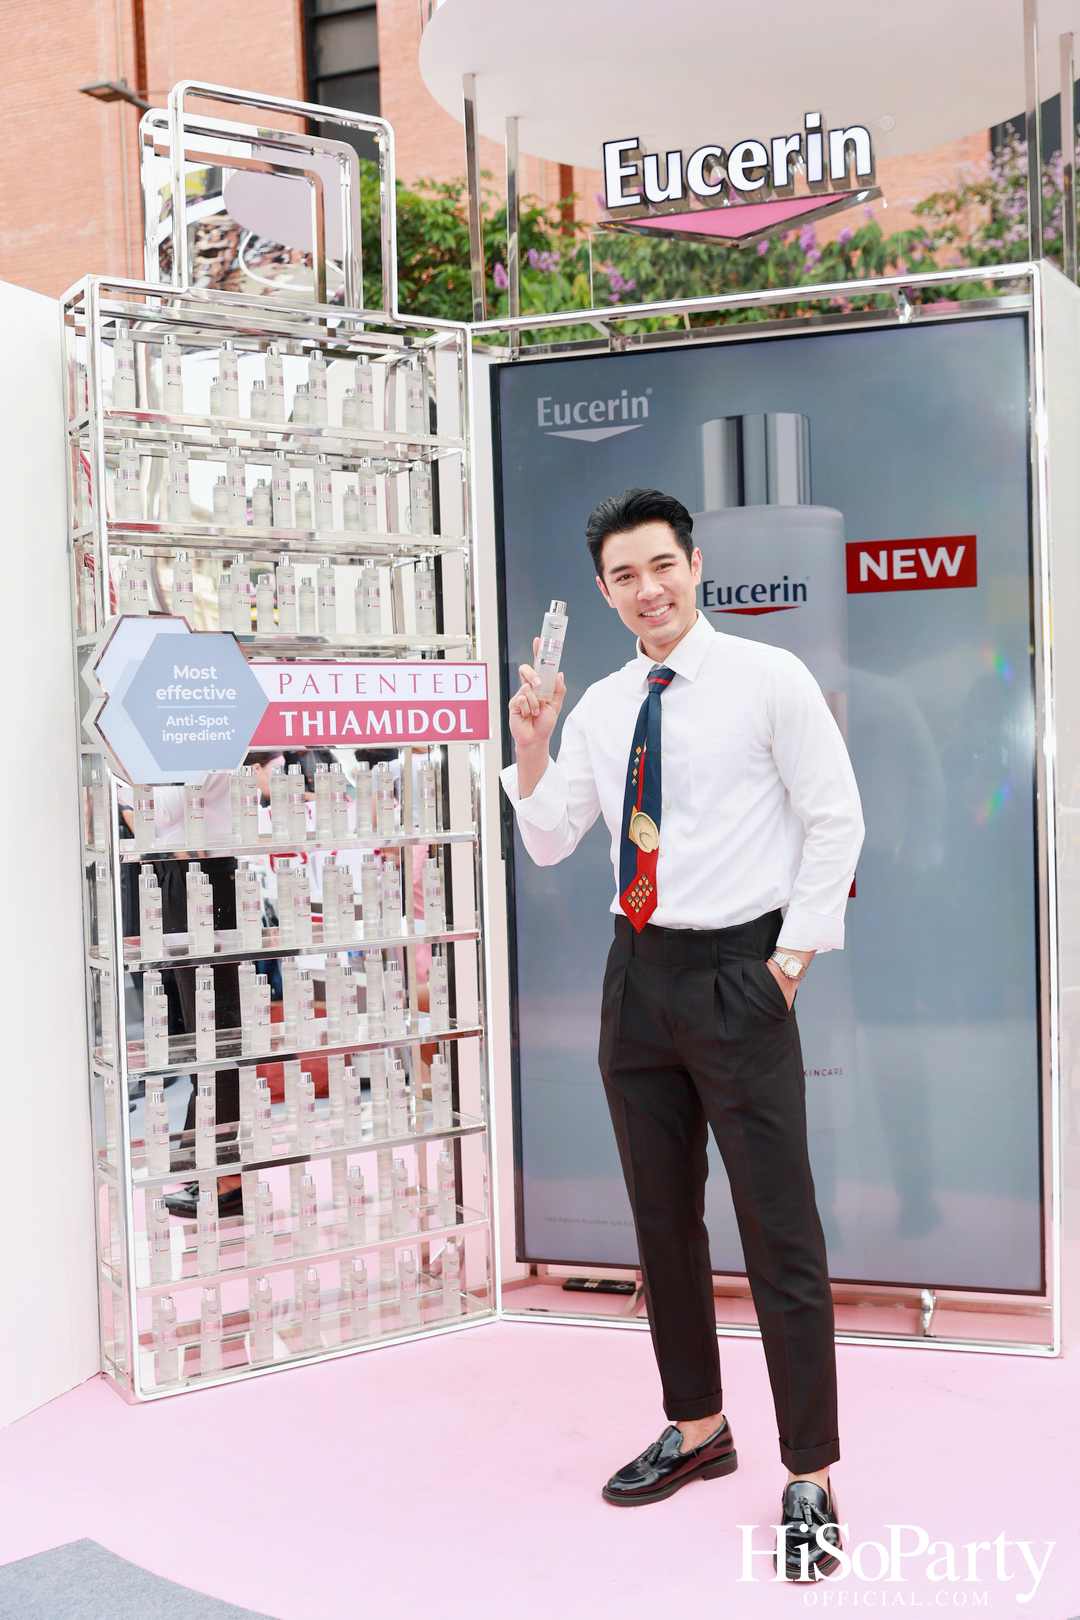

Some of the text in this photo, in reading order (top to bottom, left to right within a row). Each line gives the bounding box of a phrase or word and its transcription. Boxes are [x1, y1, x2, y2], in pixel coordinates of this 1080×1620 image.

[859, 545, 966, 582] NEW
[702, 575, 808, 608] Eucerin
[173, 664, 218, 680] Most
[155, 683, 237, 701] effective
[165, 714, 229, 728] Anti-Spot
[279, 708, 474, 737] THIAMIDOL
[803, 1067, 844, 1077] KINCARE
